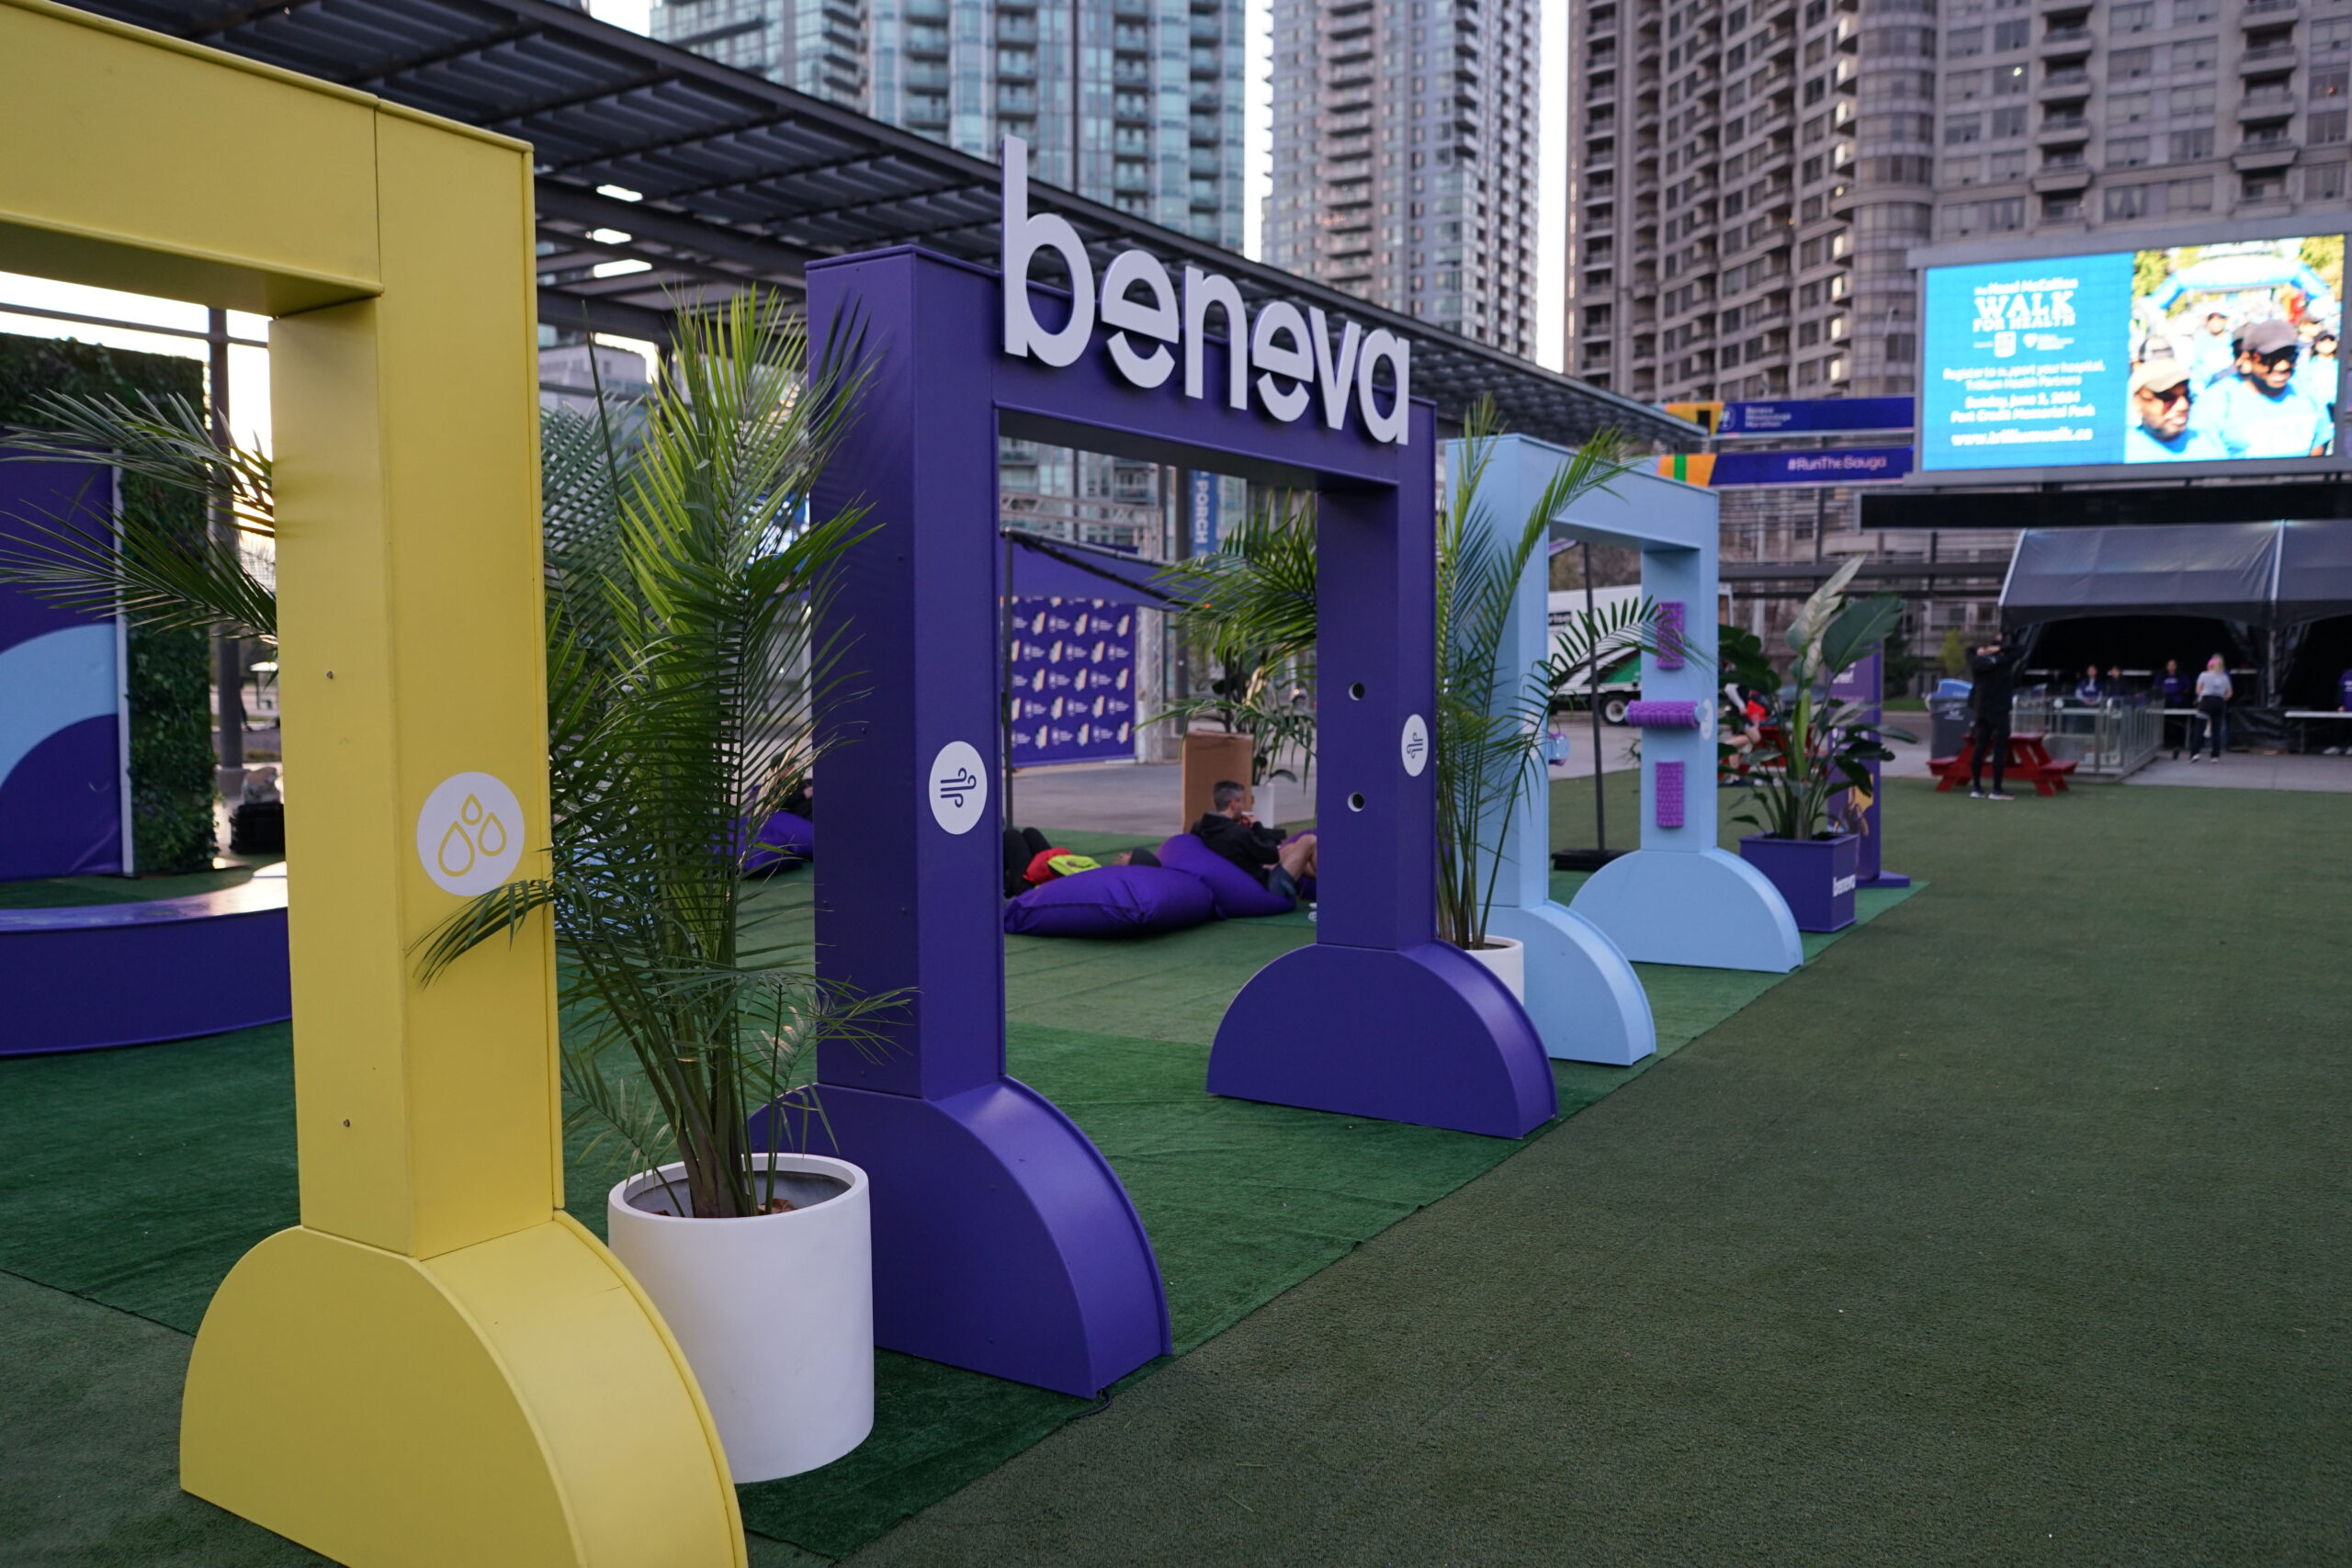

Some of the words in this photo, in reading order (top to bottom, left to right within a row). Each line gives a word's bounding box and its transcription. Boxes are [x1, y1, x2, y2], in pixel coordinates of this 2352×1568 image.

[1001, 133, 1410, 446] beneva
[1975, 291, 2074, 318] WALK
[1973, 319, 2005, 332] FOR
[2010, 312, 2075, 329] HEALTH
[1943, 368, 1984, 381] Register
[1984, 367, 1996, 377] to
[2038, 364, 2059, 376] your
[1966, 379, 2002, 390] Trillium
[2005, 377, 2037, 388] Health
[2040, 375, 2081, 387] Partners
[1966, 395, 2007, 409] Sunday,
[2010, 394, 2036, 407] June
[1951, 412, 1974, 423] Port
[1977, 410, 2011, 422] Credit
[2013, 405, 2066, 419] Memorial
[2069, 404, 2095, 417] Park
[1951, 427, 2093, 446] www.trilliumwalk.ca
[1788, 457, 1887, 470] #RunTheSauga
[1195, 479, 1210, 544] PORCH
